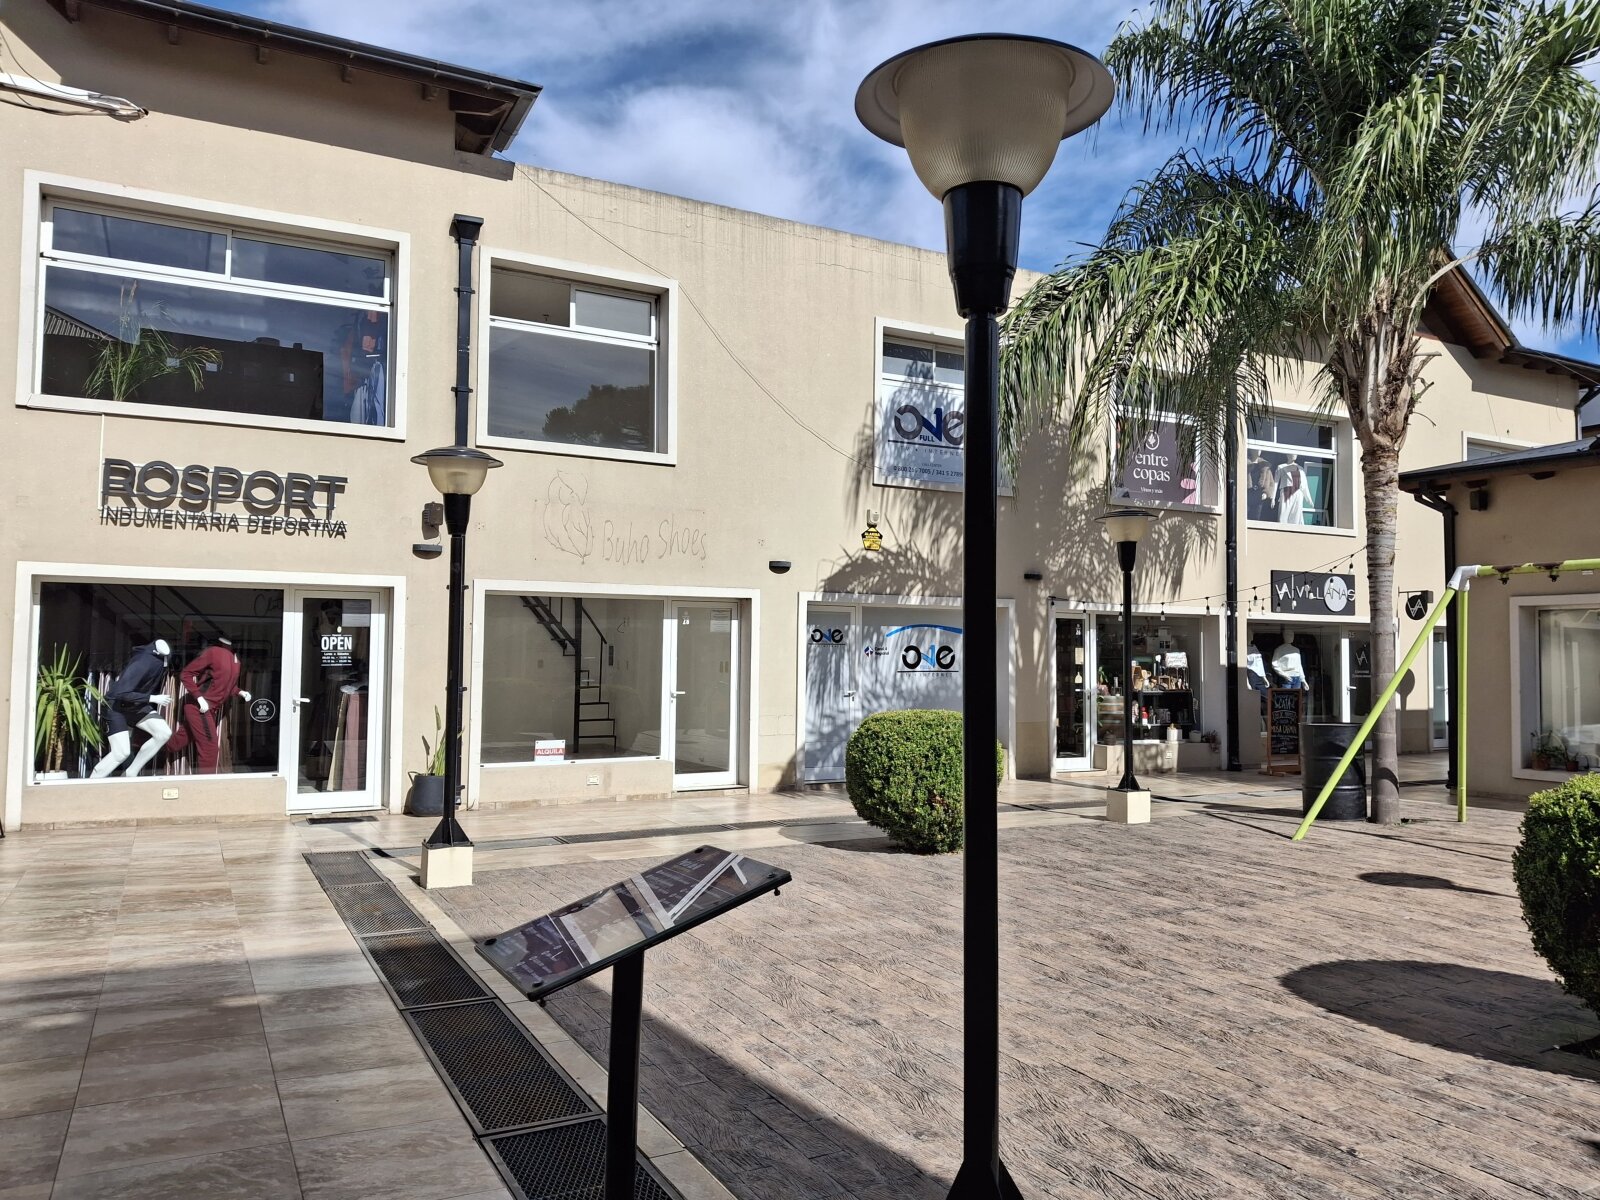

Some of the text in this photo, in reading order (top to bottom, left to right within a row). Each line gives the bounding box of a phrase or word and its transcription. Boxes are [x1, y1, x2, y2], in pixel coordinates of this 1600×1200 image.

[919, 434, 935, 443] FULL
[924, 448, 964, 457] INTERNE
[1134, 452, 1169, 467] entre
[1133, 467, 1171, 485] copas
[102, 457, 349, 512] ROSPORT
[101, 505, 348, 536] INDUMENTARIA DEPORTIVA
[602, 513, 707, 566] Buho Shoes
[321, 636, 353, 651] OPEN
[536, 748, 564, 756] ALQUILA
